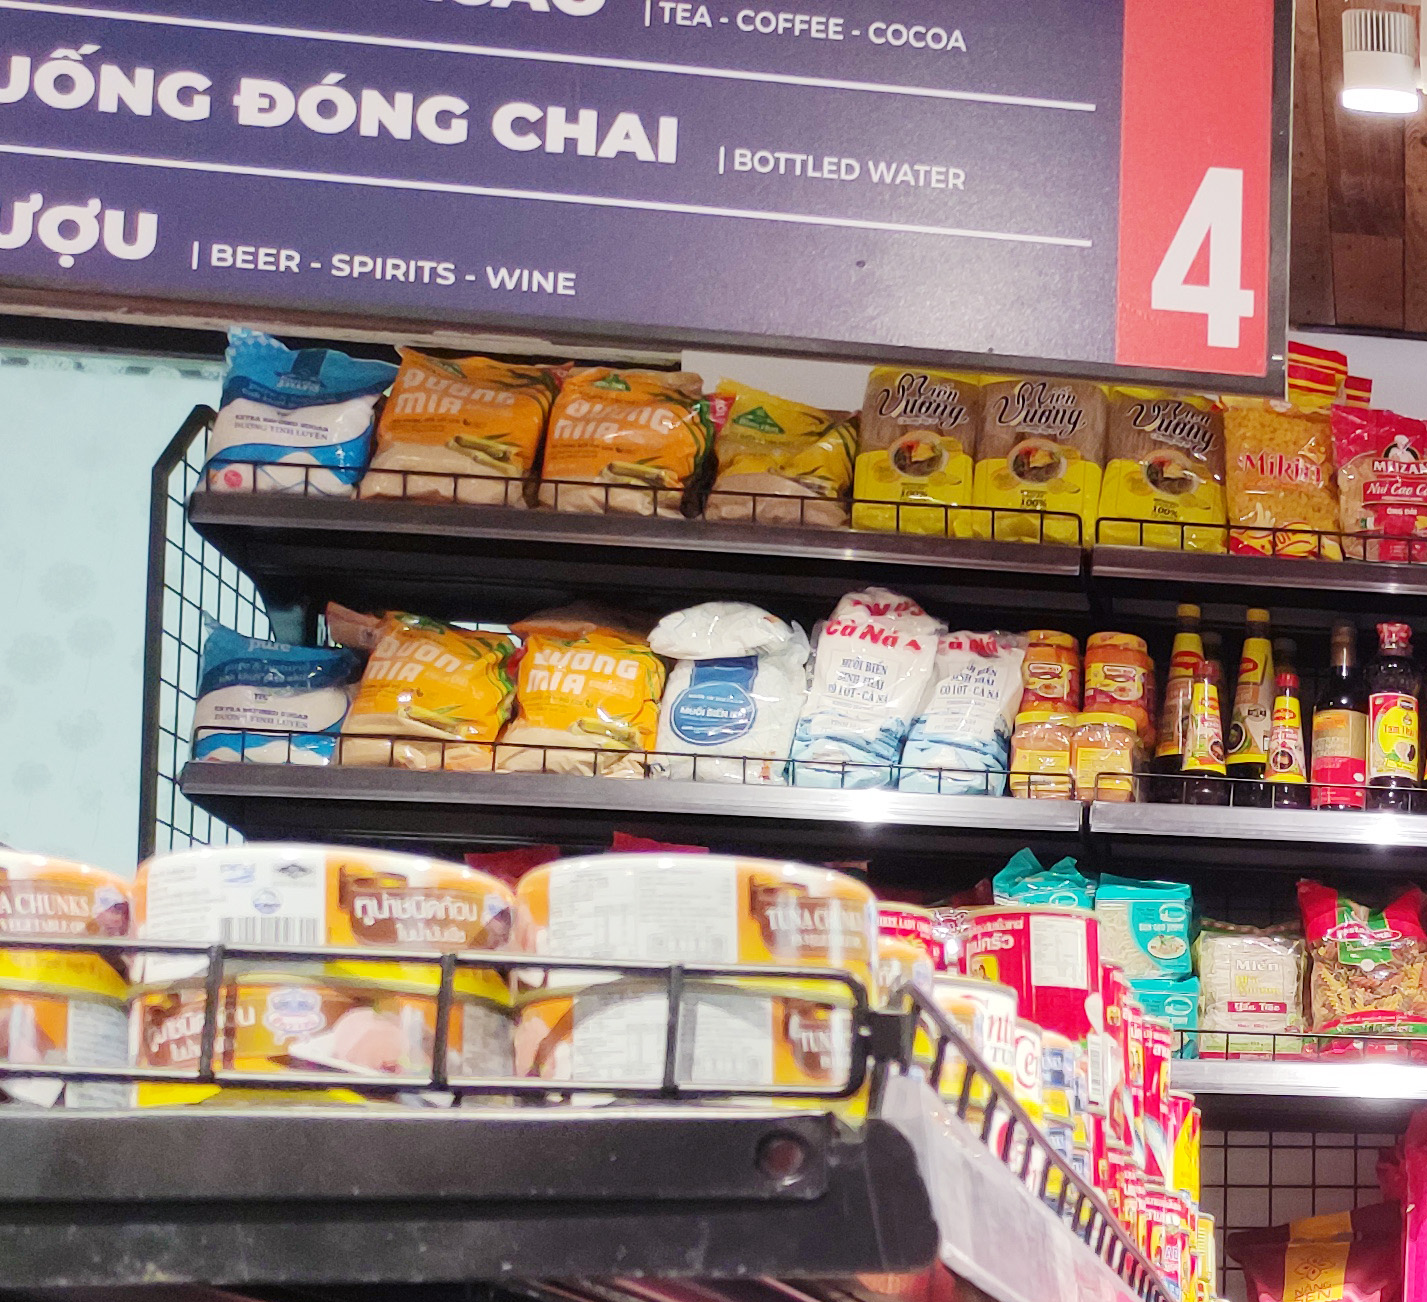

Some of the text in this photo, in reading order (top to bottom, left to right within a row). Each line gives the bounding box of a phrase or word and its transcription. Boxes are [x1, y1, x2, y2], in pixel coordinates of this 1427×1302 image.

[658, 2, 967, 52] TEA COFFEE COCOA
[234, 73, 469, 147] ĐÓNG
[492, 102, 678, 165] CHAI
[733, 149, 966, 190] BOTTLED WATER
[210, 243, 577, 297] BEER SPIRITS WINE
[1150, 166, 1255, 348] 4
